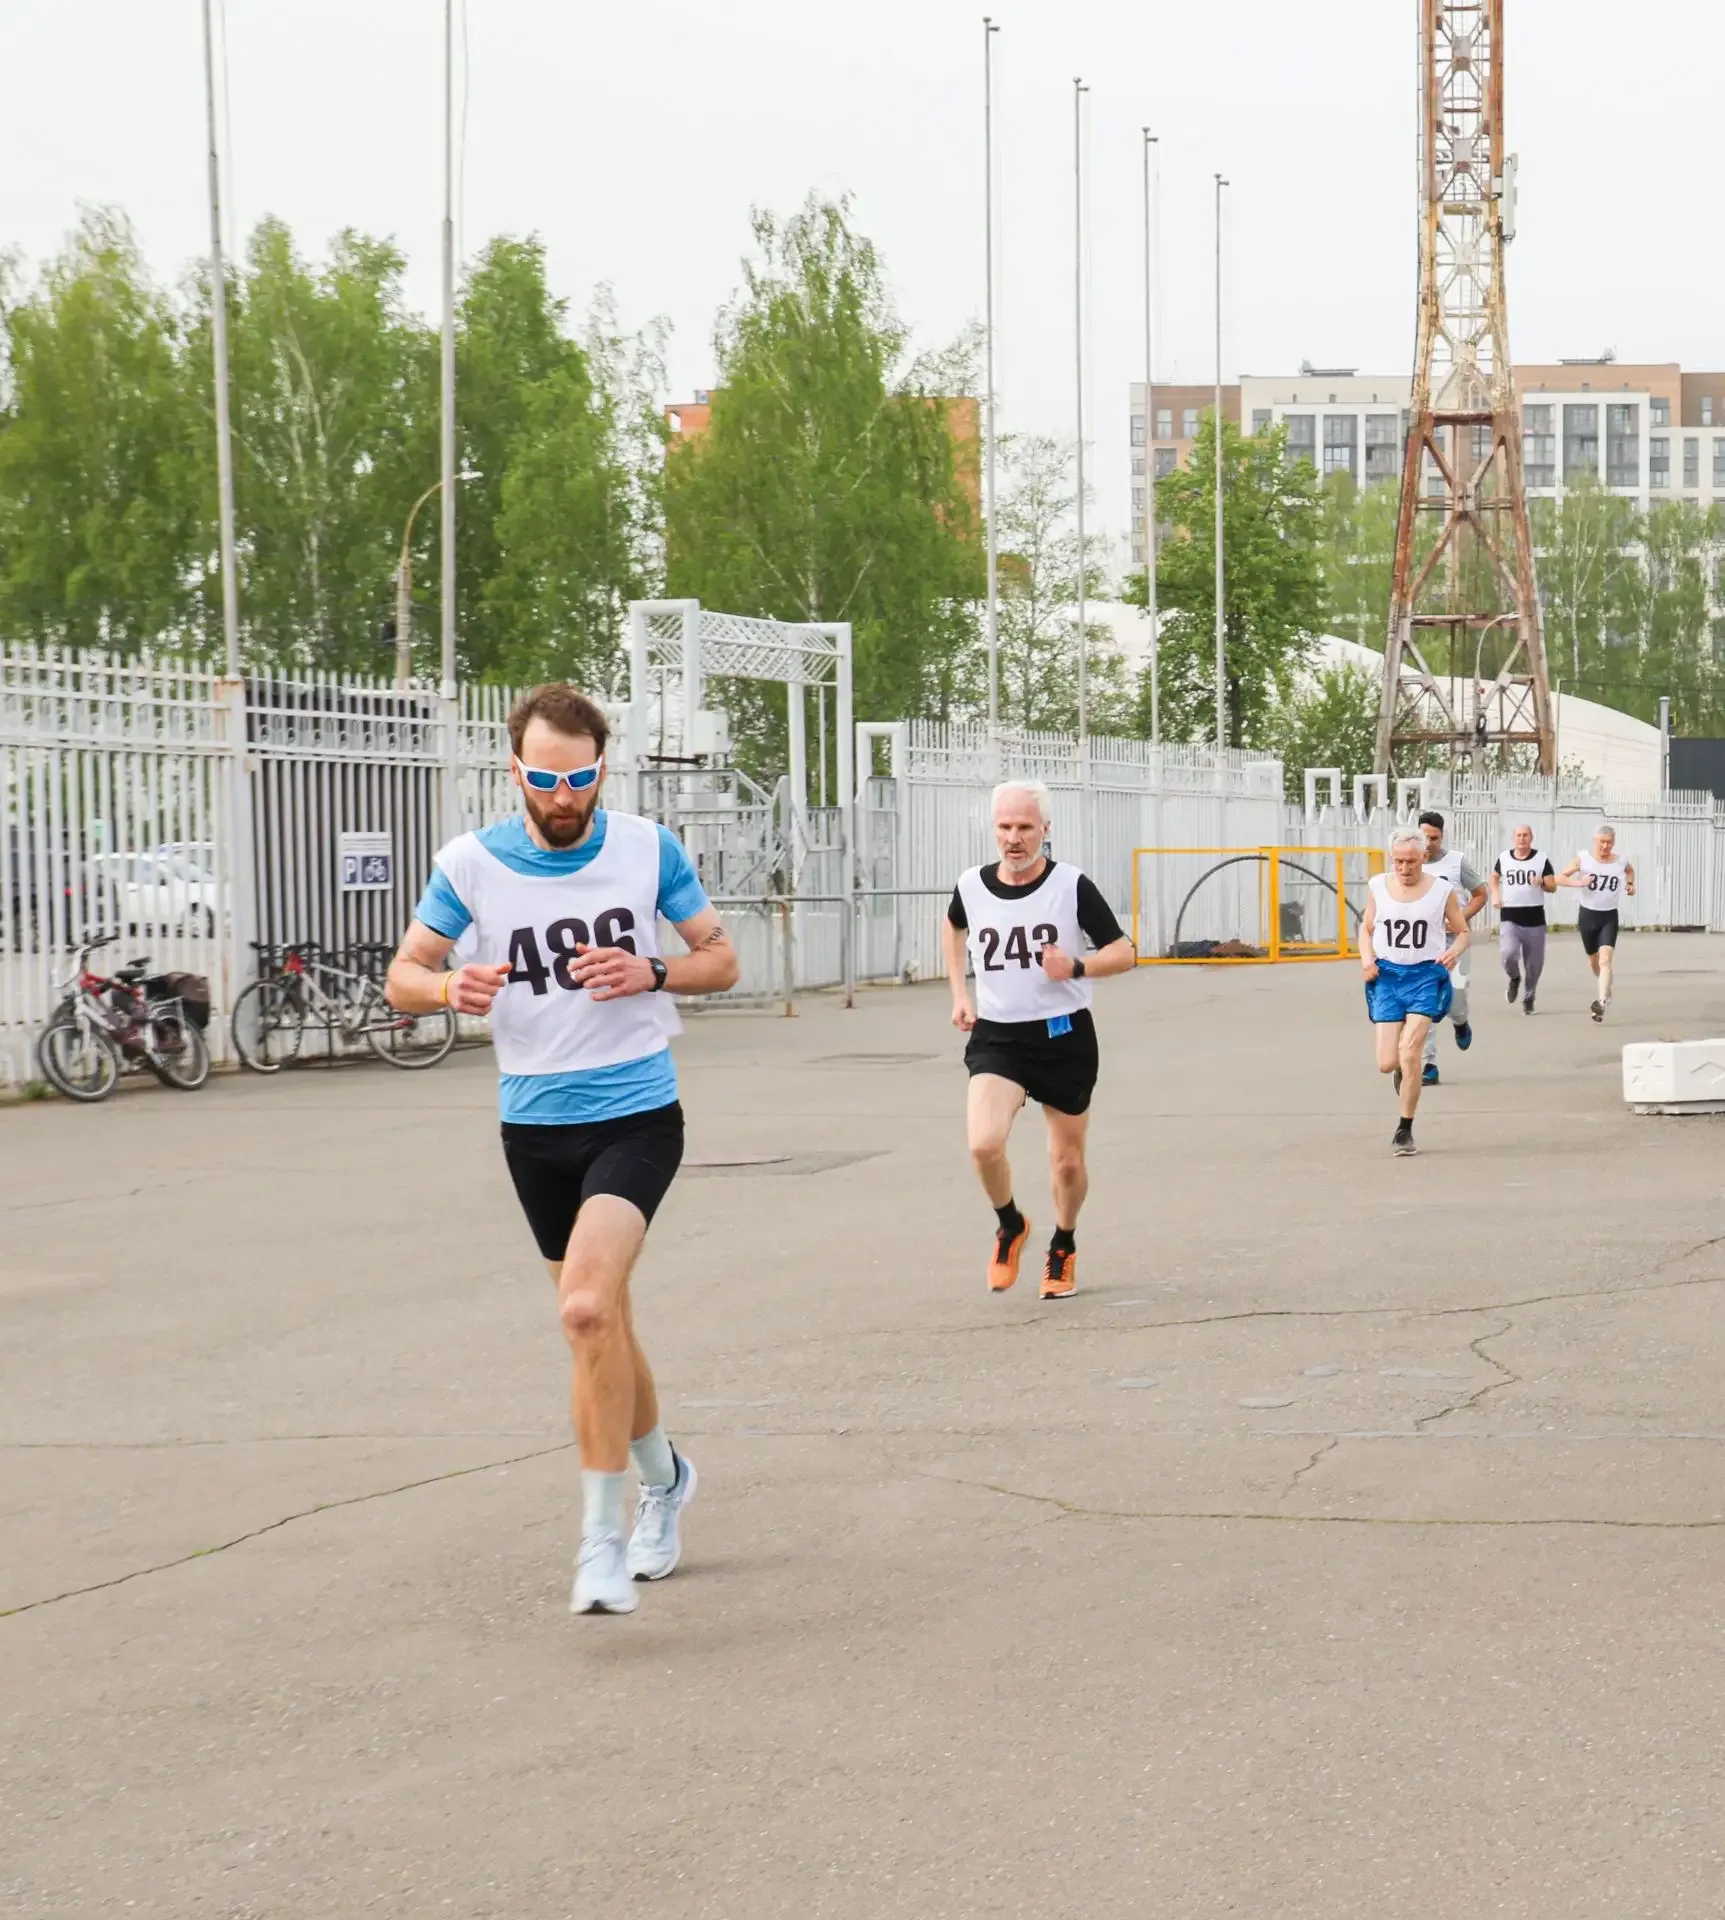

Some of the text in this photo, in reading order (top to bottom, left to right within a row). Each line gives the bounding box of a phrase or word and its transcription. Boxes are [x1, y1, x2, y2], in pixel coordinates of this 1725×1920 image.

[346, 858, 357, 882] P
[1506, 869, 1537, 886] 500
[978, 923, 1058, 971] 243
[1383, 918, 1428, 949] 120
[508, 907, 637, 996] 486
